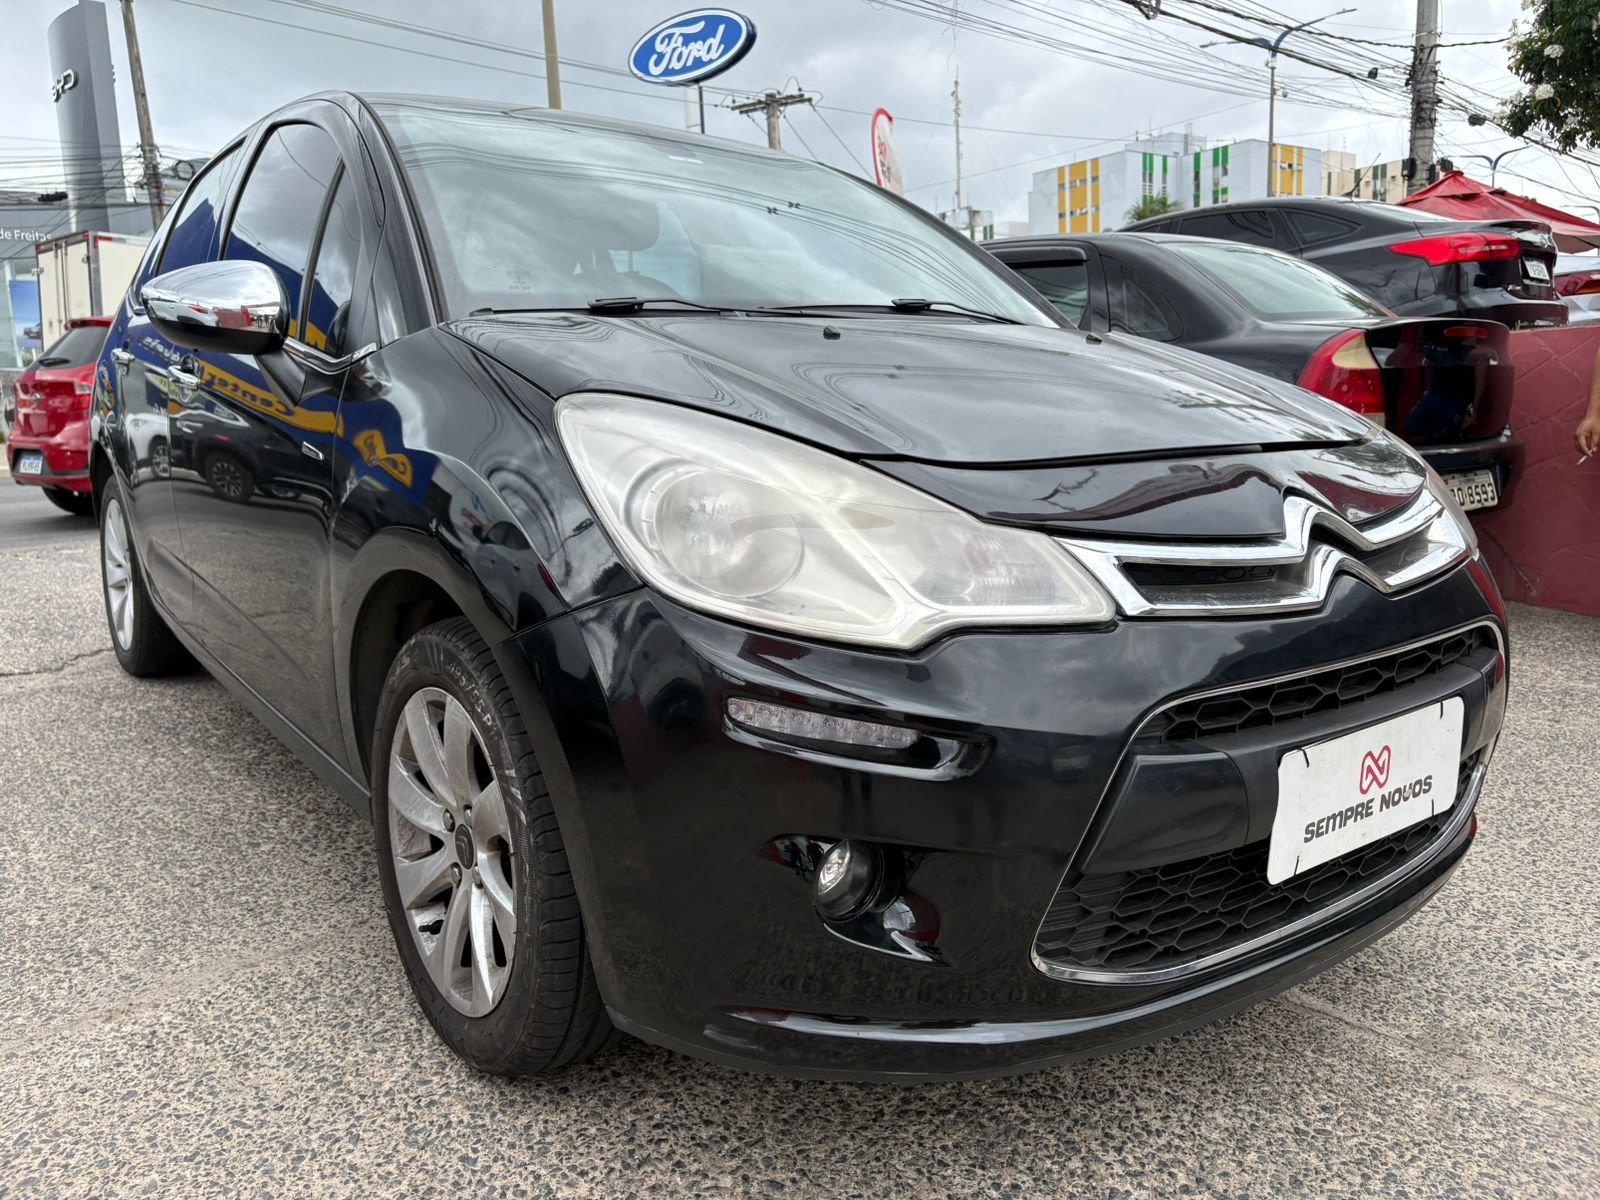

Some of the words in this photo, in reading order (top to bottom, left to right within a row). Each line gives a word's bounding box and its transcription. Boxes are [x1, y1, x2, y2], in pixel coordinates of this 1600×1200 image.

[648, 20, 725, 76] Ford
[0, 228, 11, 240] de
[1303, 797, 1375, 843] SEMPRE
